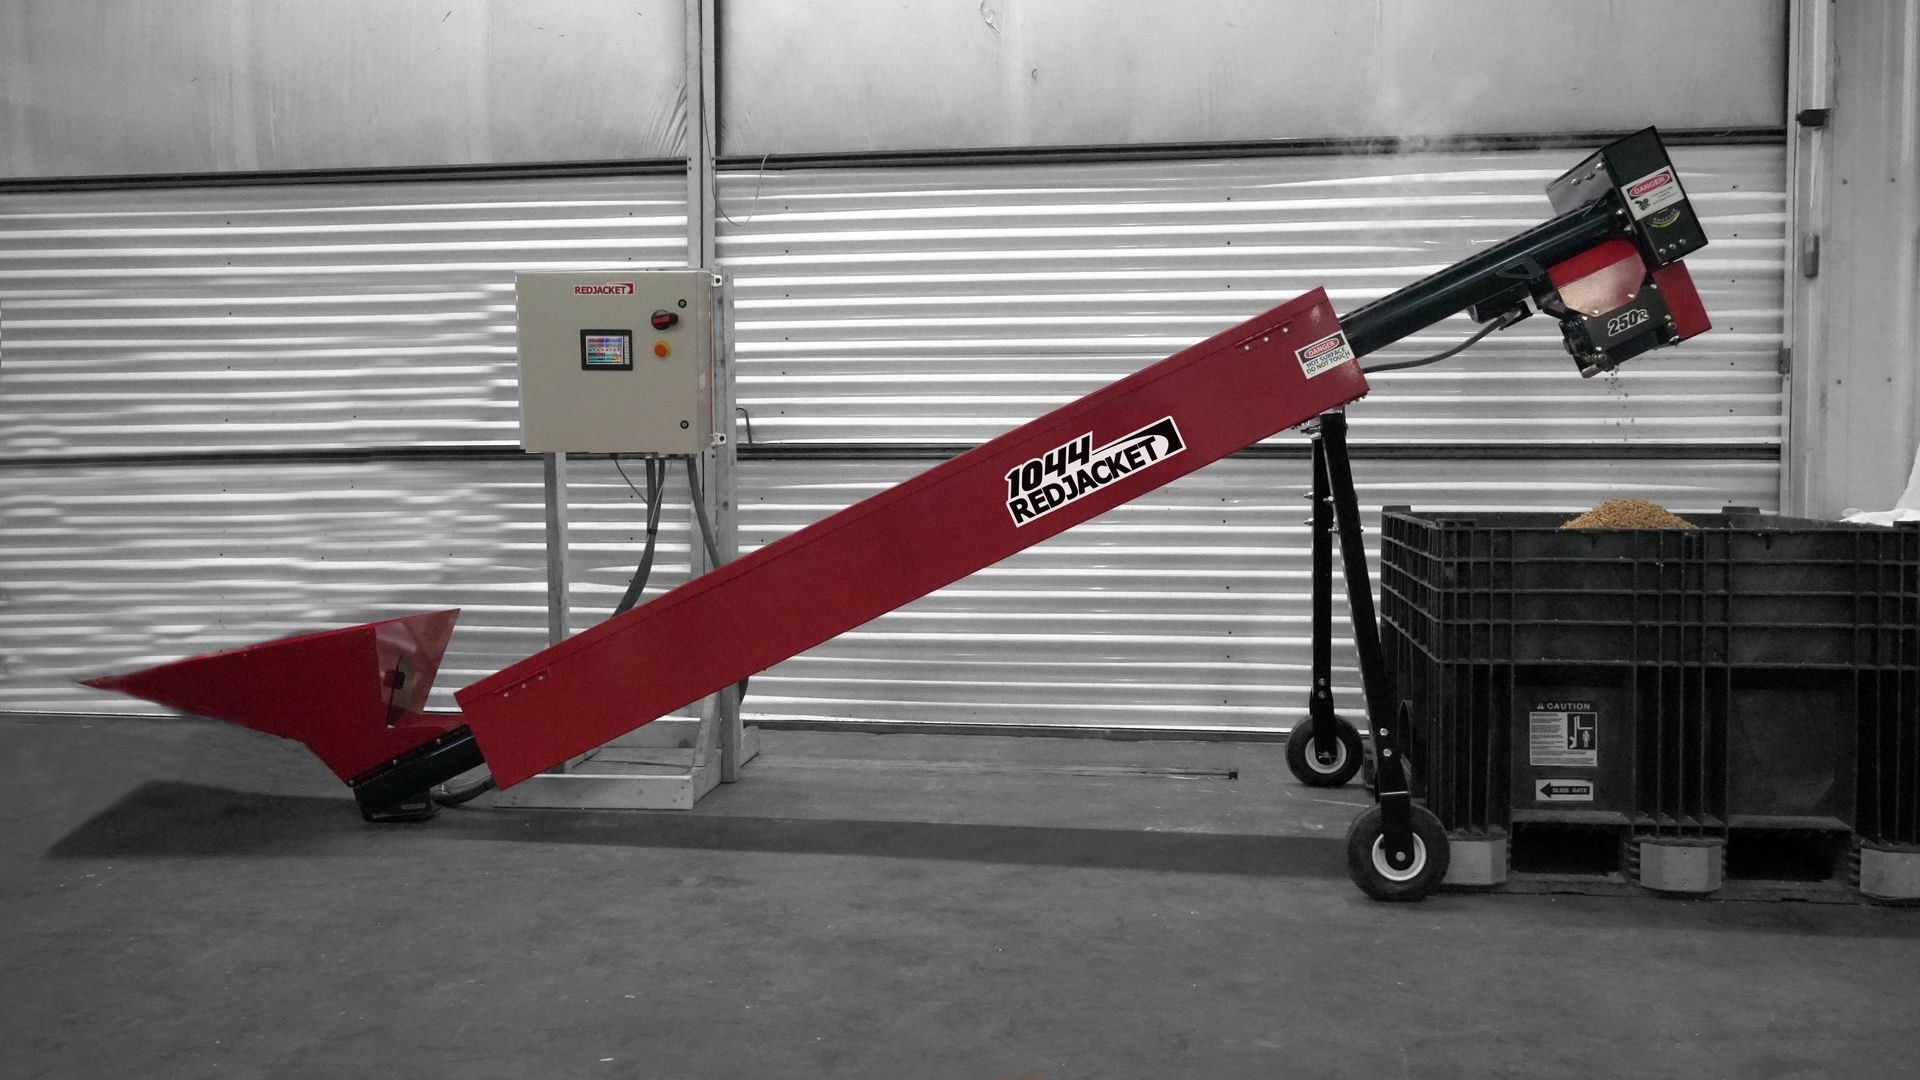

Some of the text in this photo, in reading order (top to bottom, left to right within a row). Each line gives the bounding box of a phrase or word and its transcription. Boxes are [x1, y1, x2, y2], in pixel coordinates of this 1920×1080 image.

[1633, 176, 1666, 195] DANGER
[574, 286, 627, 295] REDJACKET
[1608, 309, 1650, 336] 250R
[1306, 346, 1345, 368] HOT SURFACE
[1308, 340, 1336, 356] DANGER
[1306, 351, 1351, 374] DO NOT TOUCH
[1007, 434, 1091, 499] 1044
[1008, 435, 1158, 524] REDJACKET
[1547, 702, 1590, 710] CAUTION
